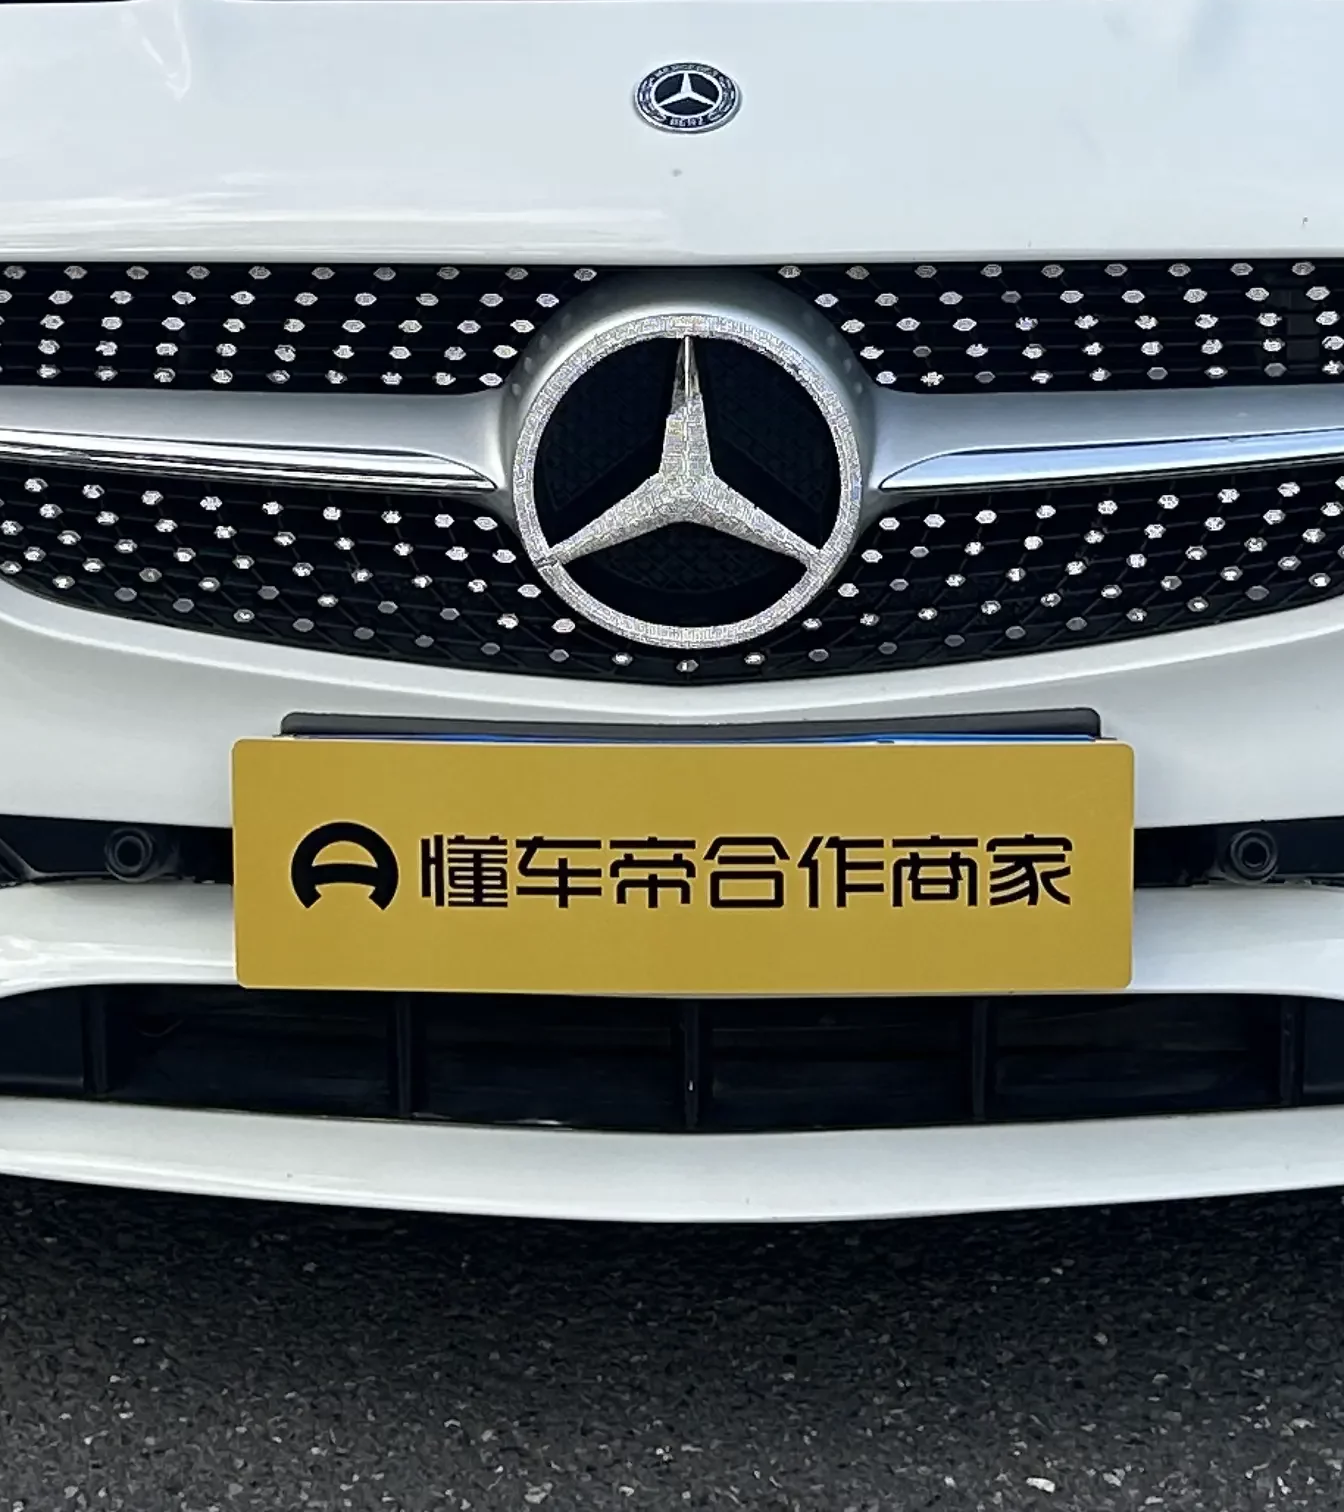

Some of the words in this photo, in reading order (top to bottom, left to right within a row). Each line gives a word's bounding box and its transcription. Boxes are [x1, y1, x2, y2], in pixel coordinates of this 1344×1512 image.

[419, 833, 1073, 909] 懂车帝合作商家
